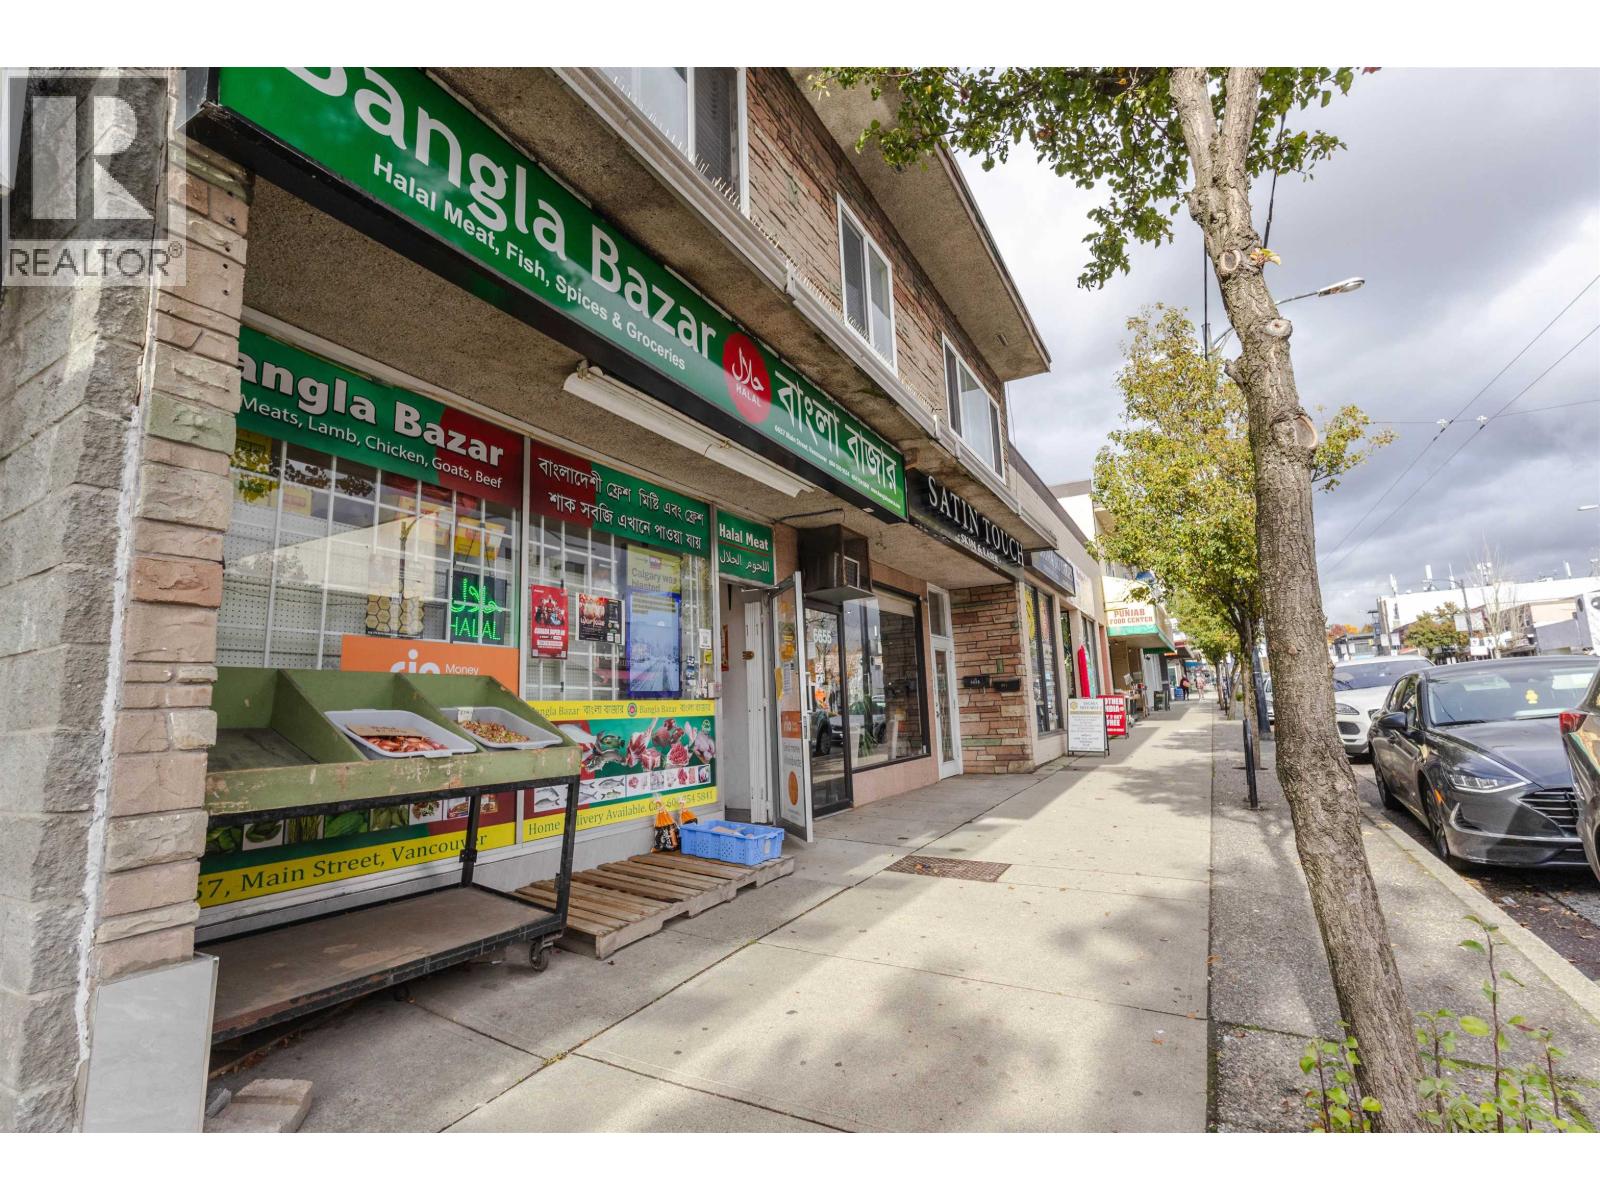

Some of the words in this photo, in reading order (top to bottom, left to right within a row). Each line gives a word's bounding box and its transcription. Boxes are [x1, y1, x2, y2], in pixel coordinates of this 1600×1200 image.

[284, 67, 567, 262] angla
[591, 224, 717, 359] Bazar
[373, 153, 436, 212] Halal
[444, 200, 500, 255] Meat,
[506, 241, 550, 287] Fish,
[555, 274, 608, 321] Spices
[611, 312, 623, 331] &
[626, 322, 686, 370] Groceries
[731, 347, 764, 391] حلال
[736, 384, 762, 408] HALAL
[238, 351, 377, 426] angla
[394, 401, 504, 468] Bazar
[774, 370, 840, 457] বাংলা
[844, 423, 897, 495] বাজার
[240, 394, 304, 429] Meats,
[308, 415, 361, 447] Lamb,
[365, 434, 429, 468] Chicken,
[432, 456, 473, 481] Goats,
[475, 470, 503, 489] Beef
[537, 457, 603, 494] বাংলাদেশী
[606, 482, 632, 503] ফ্রেশ
[638, 487, 660, 511] মিষ্টি
[663, 502, 683, 521] এবং
[548, 491, 577, 514] শাক
[580, 500, 615, 525] সবজি
[618, 515, 651, 535] এখানে
[654, 524, 683, 545] পাওয়া
[685, 533, 702, 551] যায়
[719, 523, 743, 544] Halal
[745, 531, 769, 551] Meat
[928, 475, 980, 537] SATIN
[982, 519, 1025, 567] TOUCH
[719, 549, 743, 566] الحلال
[450, 617, 501, 641] HALAL
[1114, 608, 1145, 618] PUNJAB
[445, 664, 479, 675] Money
[528, 820, 561, 836] Home
[576, 812, 604, 827] livery
[240, 866, 305, 893] Main
[311, 855, 386, 880] Street,
[391, 833, 488, 863] Vancouvr
